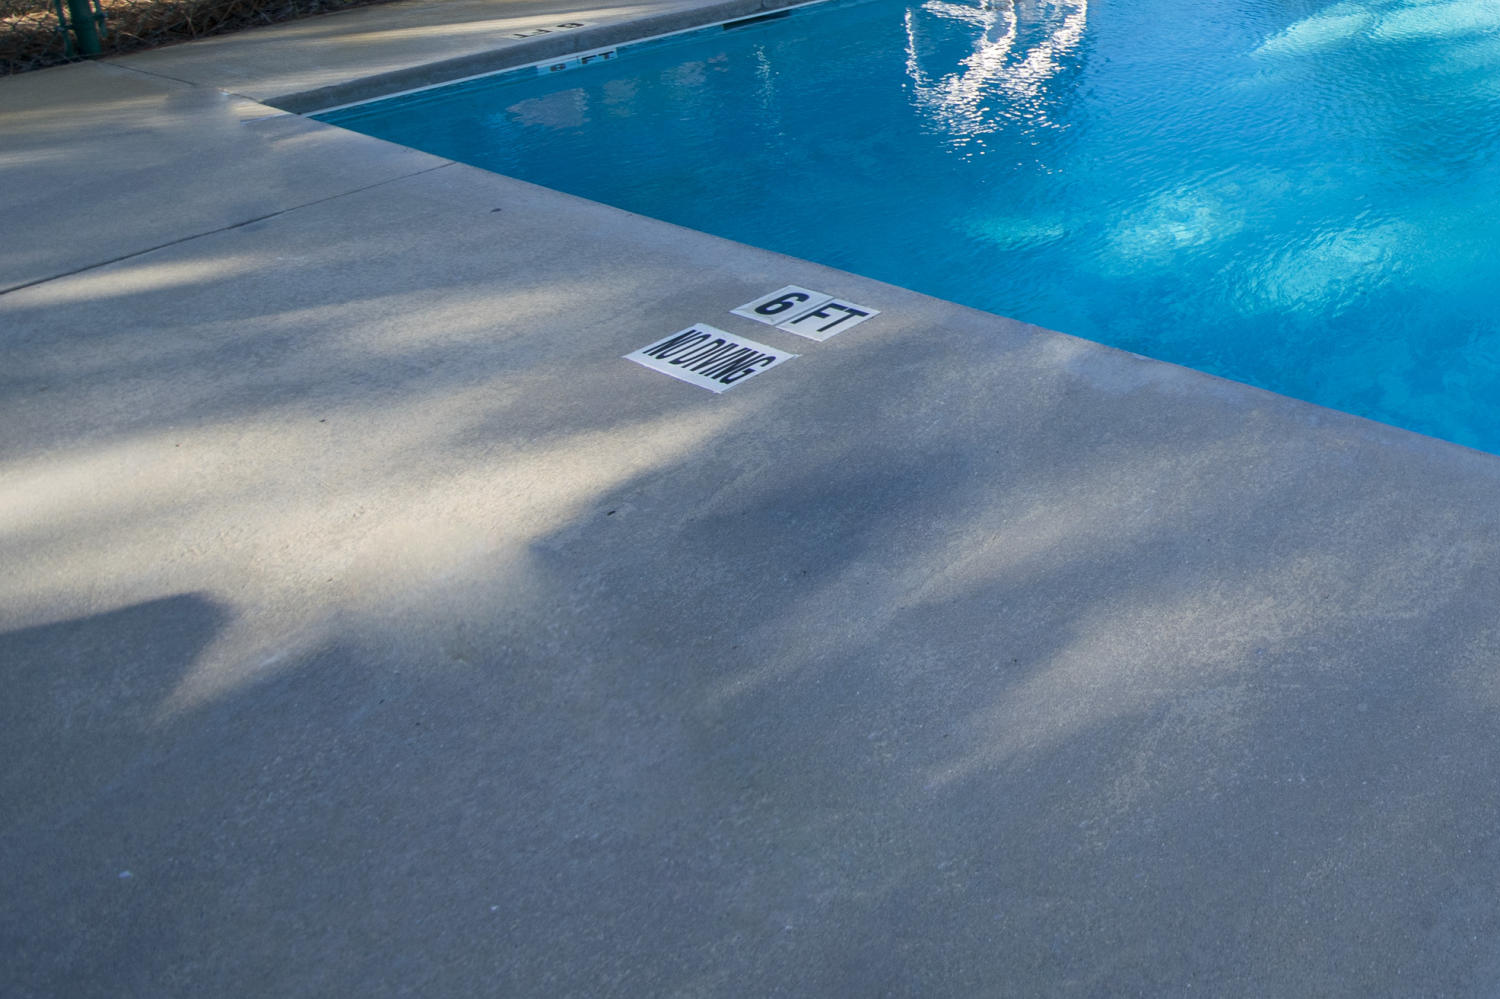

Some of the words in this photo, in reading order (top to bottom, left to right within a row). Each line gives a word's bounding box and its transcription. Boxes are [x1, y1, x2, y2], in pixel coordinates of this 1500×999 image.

[581, 50, 614, 65] FT
[754, 292, 810, 316] 6
[791, 302, 869, 333] FT
[642, 329, 711, 360] NO
[668, 338, 776, 385] DIVING
